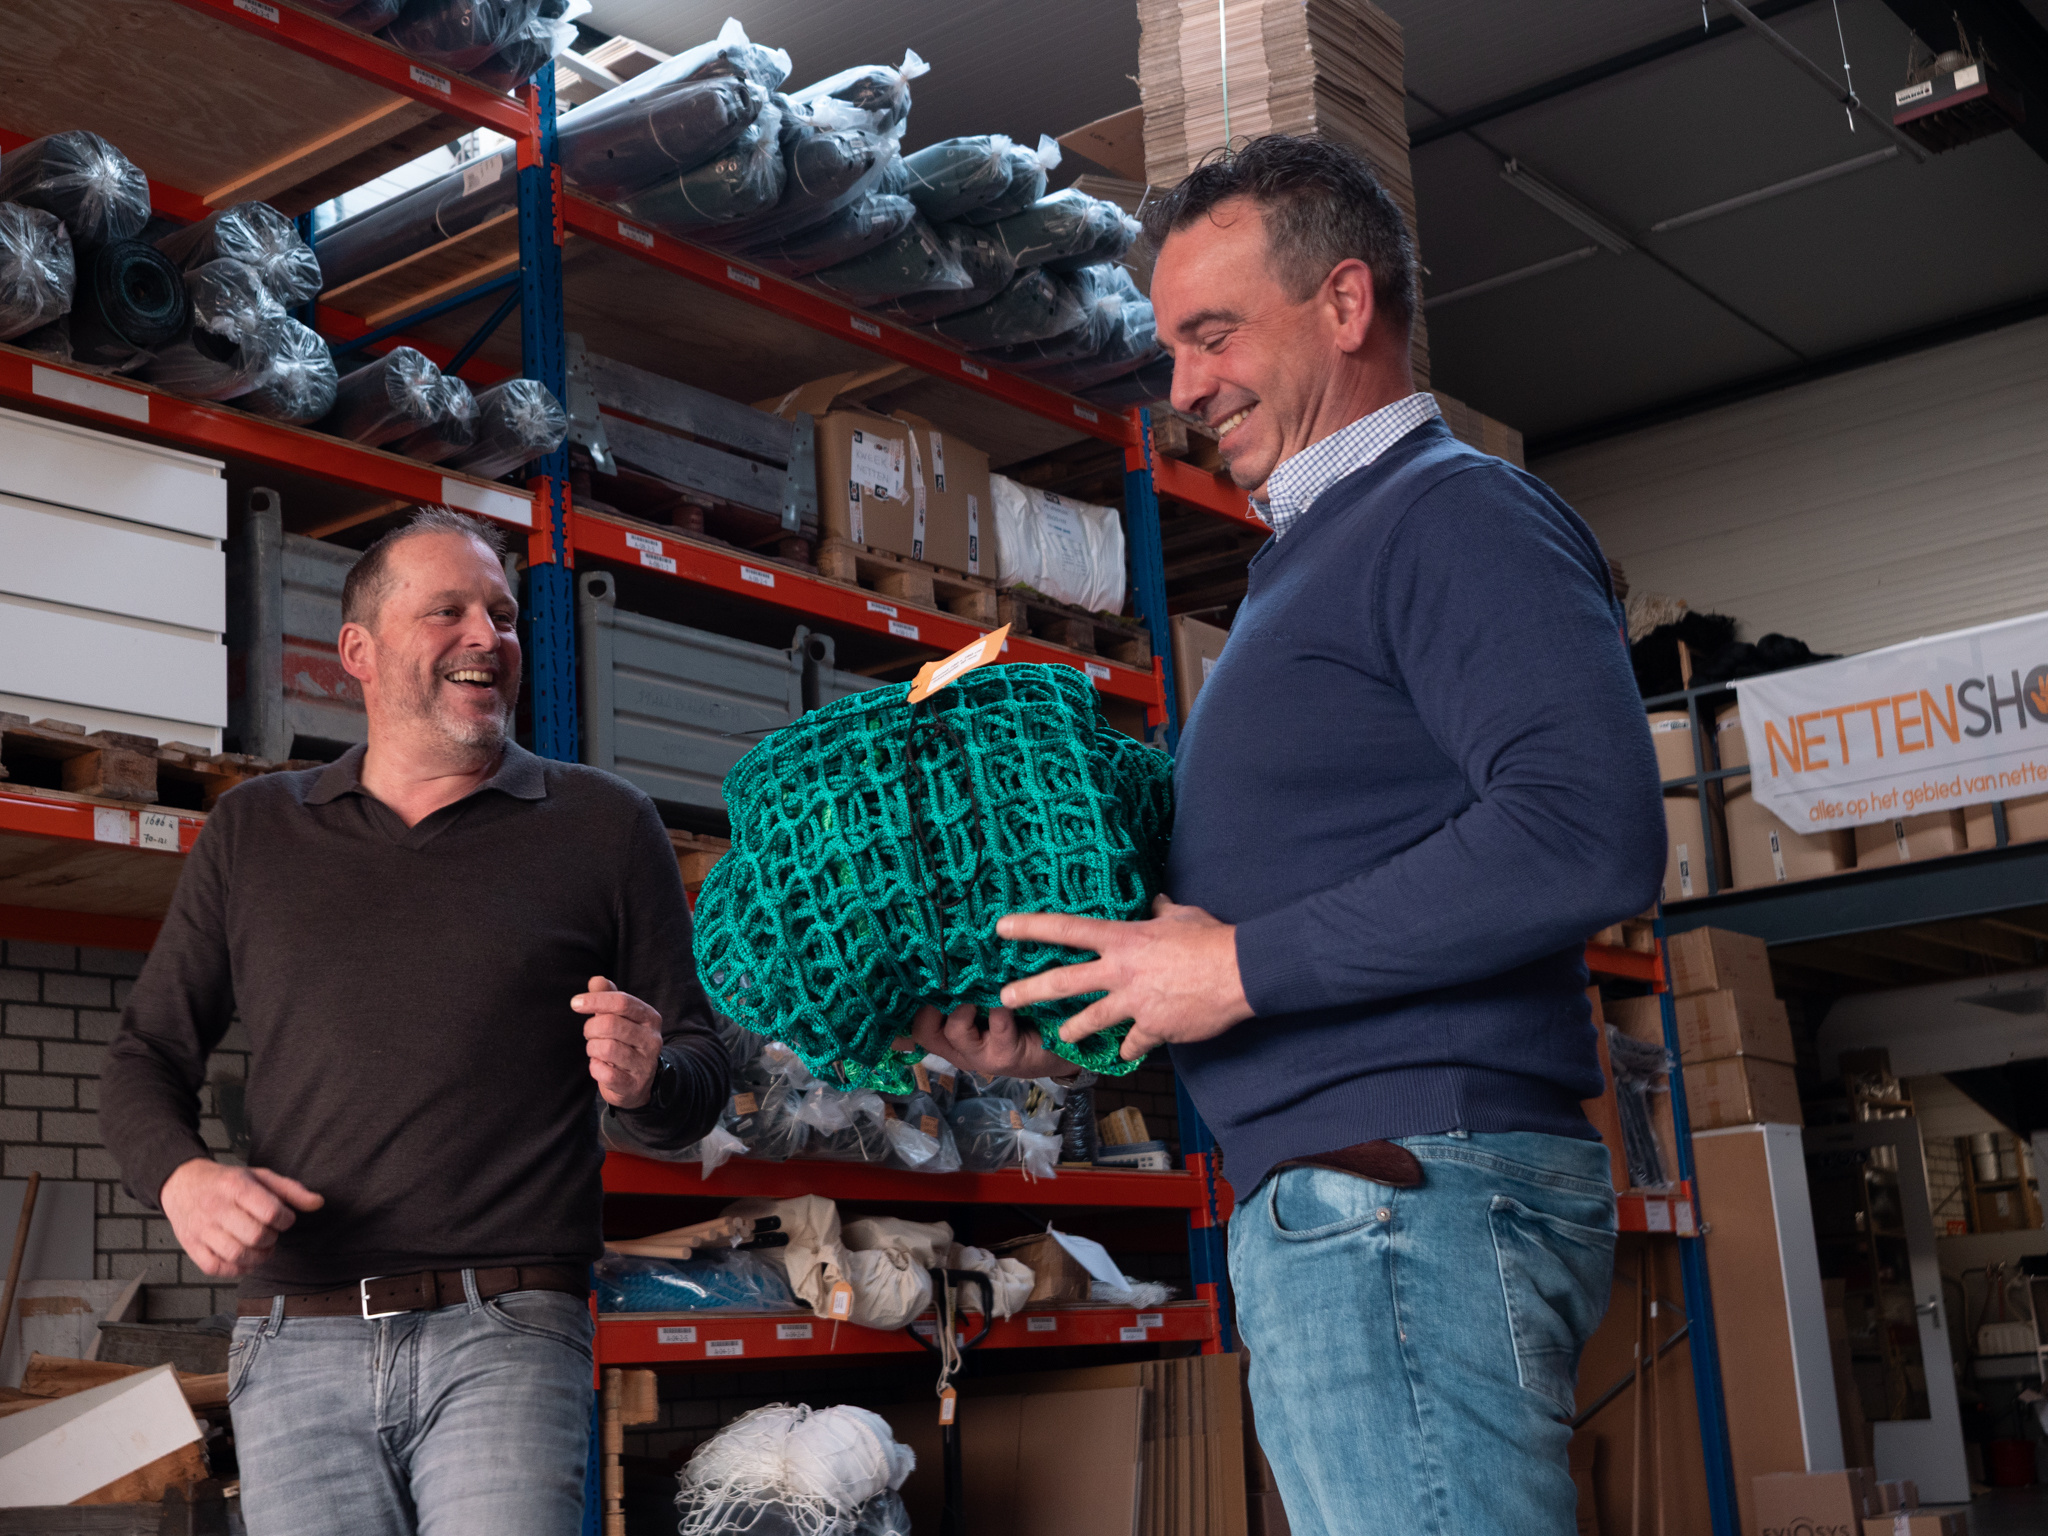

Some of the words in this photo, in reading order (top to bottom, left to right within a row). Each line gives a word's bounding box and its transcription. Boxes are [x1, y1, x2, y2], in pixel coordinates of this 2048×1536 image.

[1809, 799, 1844, 821] alles
[1846, 797, 1869, 820] op
[1870, 786, 1898, 811] het
[1902, 774, 1962, 811] gebied
[1963, 773, 1997, 795] van
[1999, 760, 2048, 789] nette
